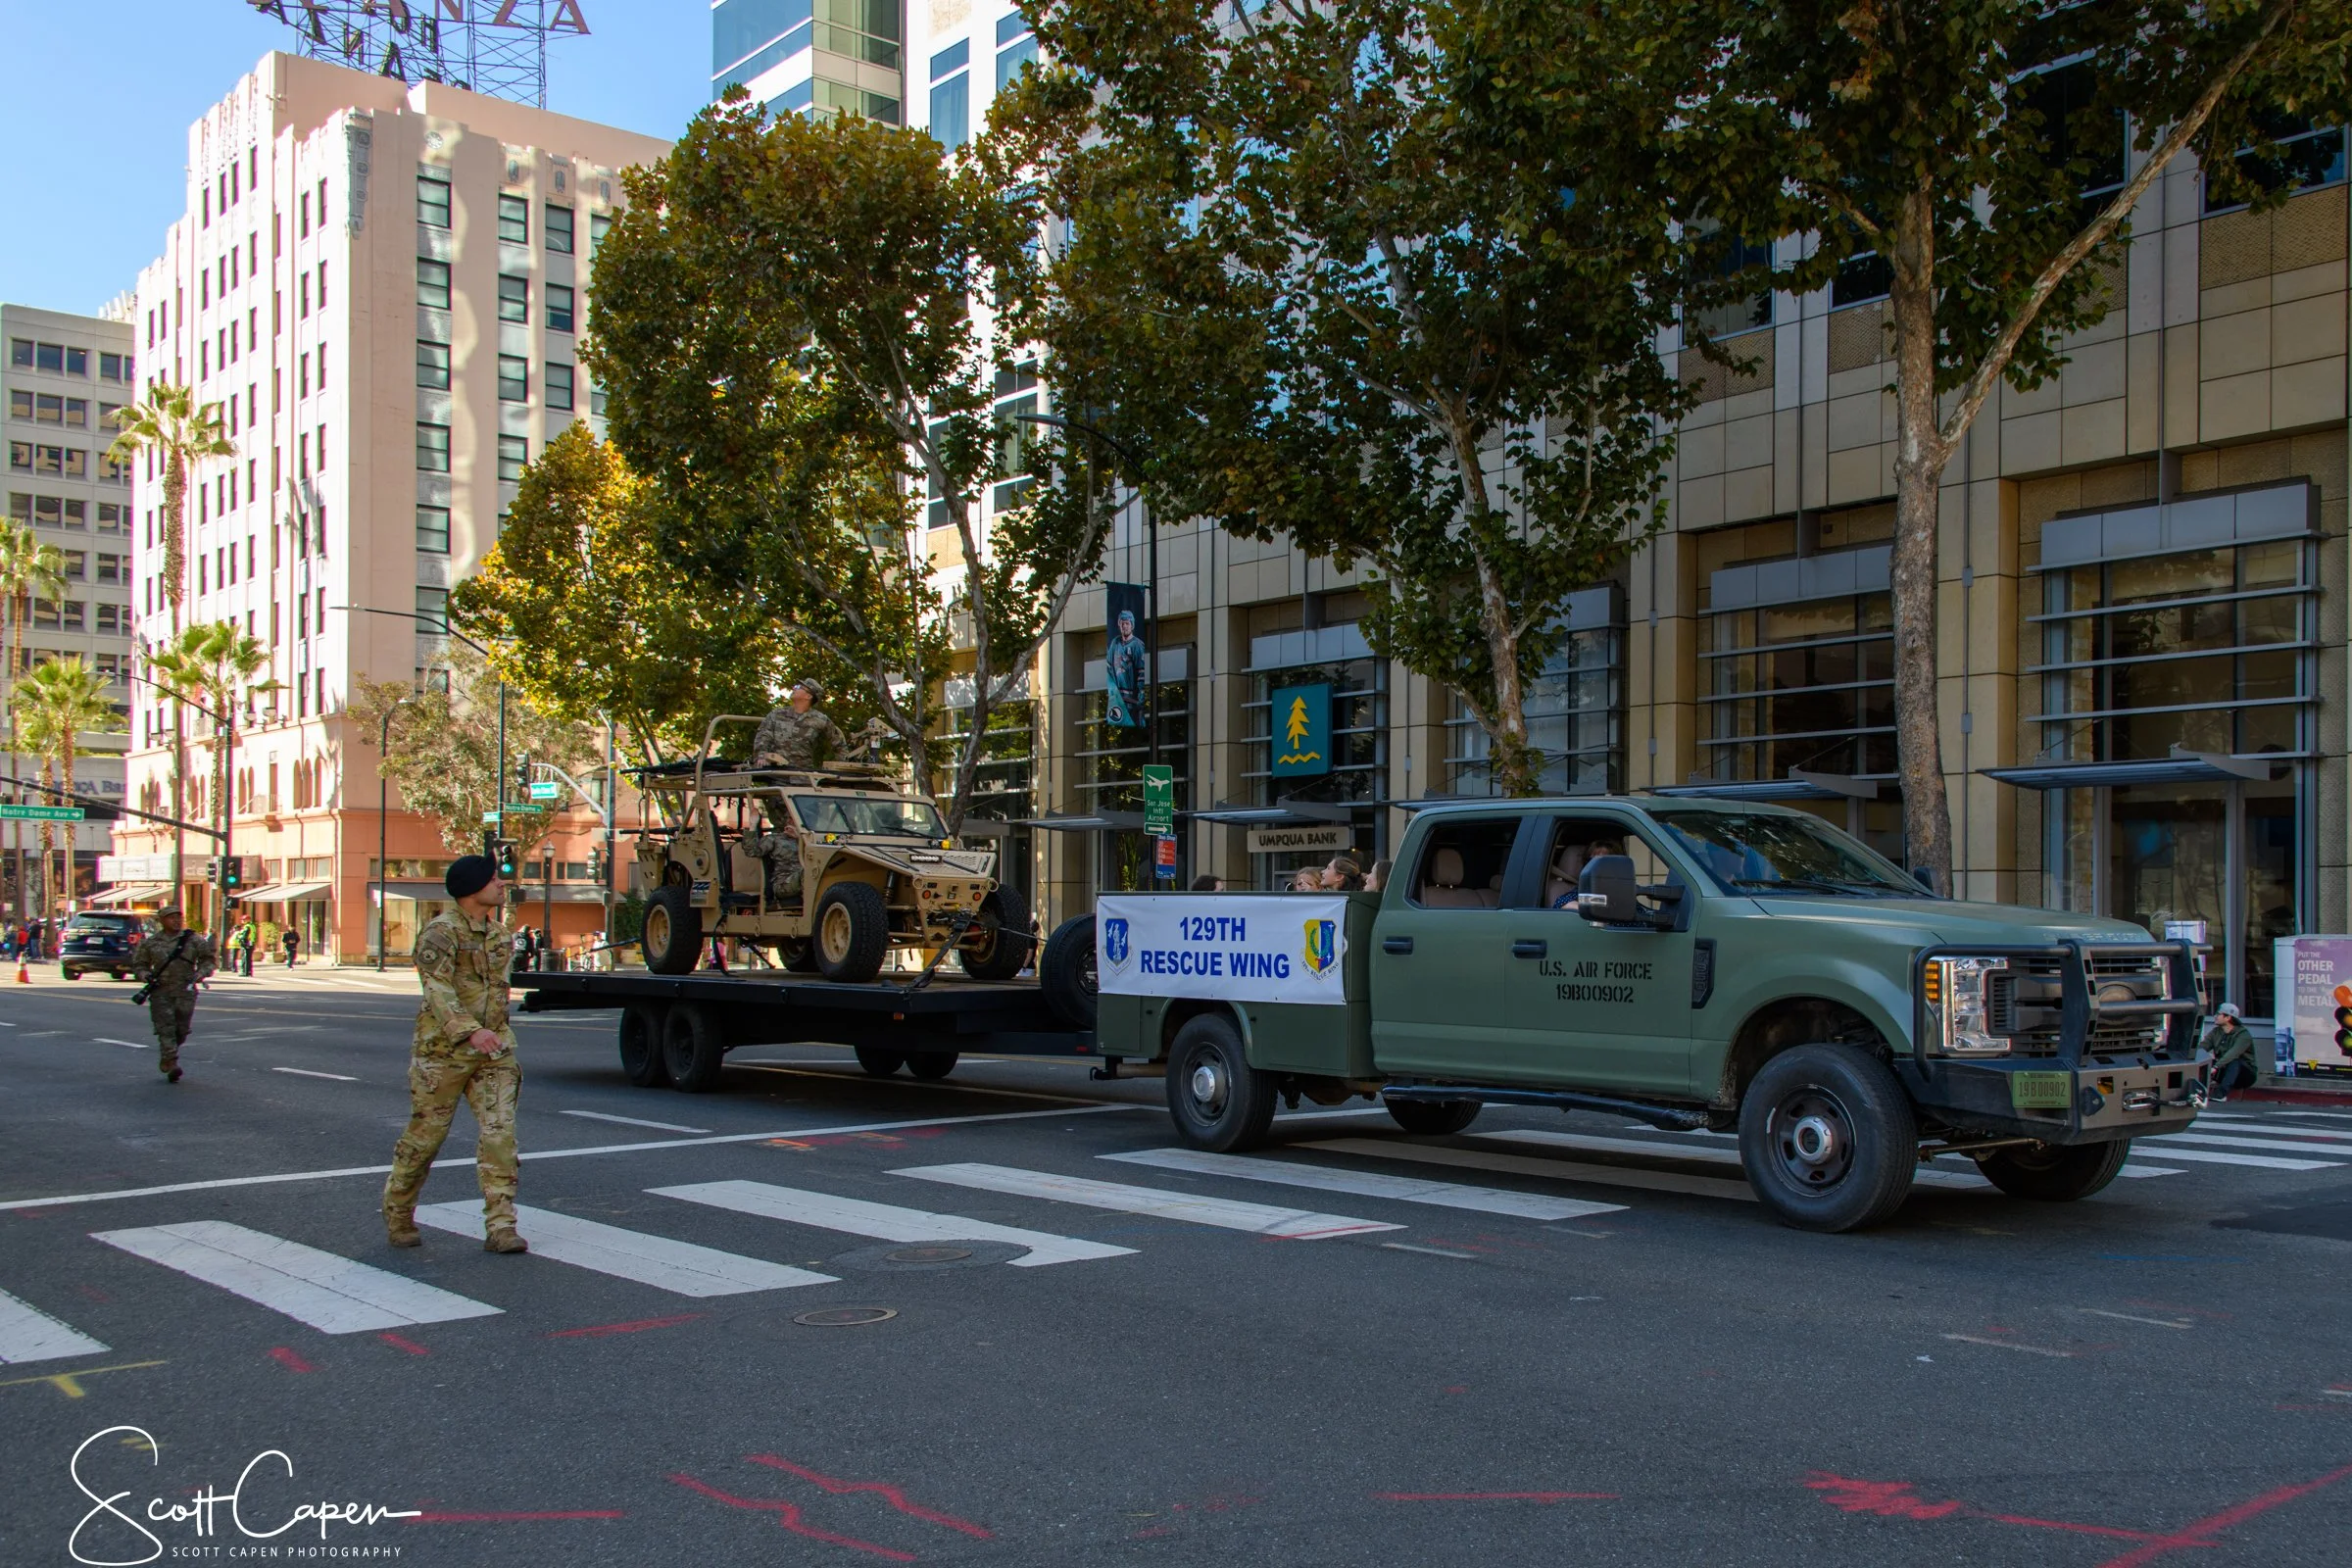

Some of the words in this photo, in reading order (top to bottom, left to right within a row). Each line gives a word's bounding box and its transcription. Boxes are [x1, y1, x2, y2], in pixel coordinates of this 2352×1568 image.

[28, 808, 51, 817] Dame
[1258, 833, 1304, 847] UMPQUA
[1307, 832, 1337, 844] BANK
[1180, 916, 1246, 941] 129TH
[1141, 950, 1223, 976] RESCUE
[1229, 953, 1291, 979] WING
[1539, 960, 1567, 977] U.S.
[1574, 961, 1598, 978] AIR
[1604, 961, 1652, 980] FORCE
[2297, 959, 2333, 971] OTHER
[2297, 973, 2333, 985] PEDAL
[1556, 984, 1634, 1003] 19B00902
[2297, 995, 2334, 1006] METAL
